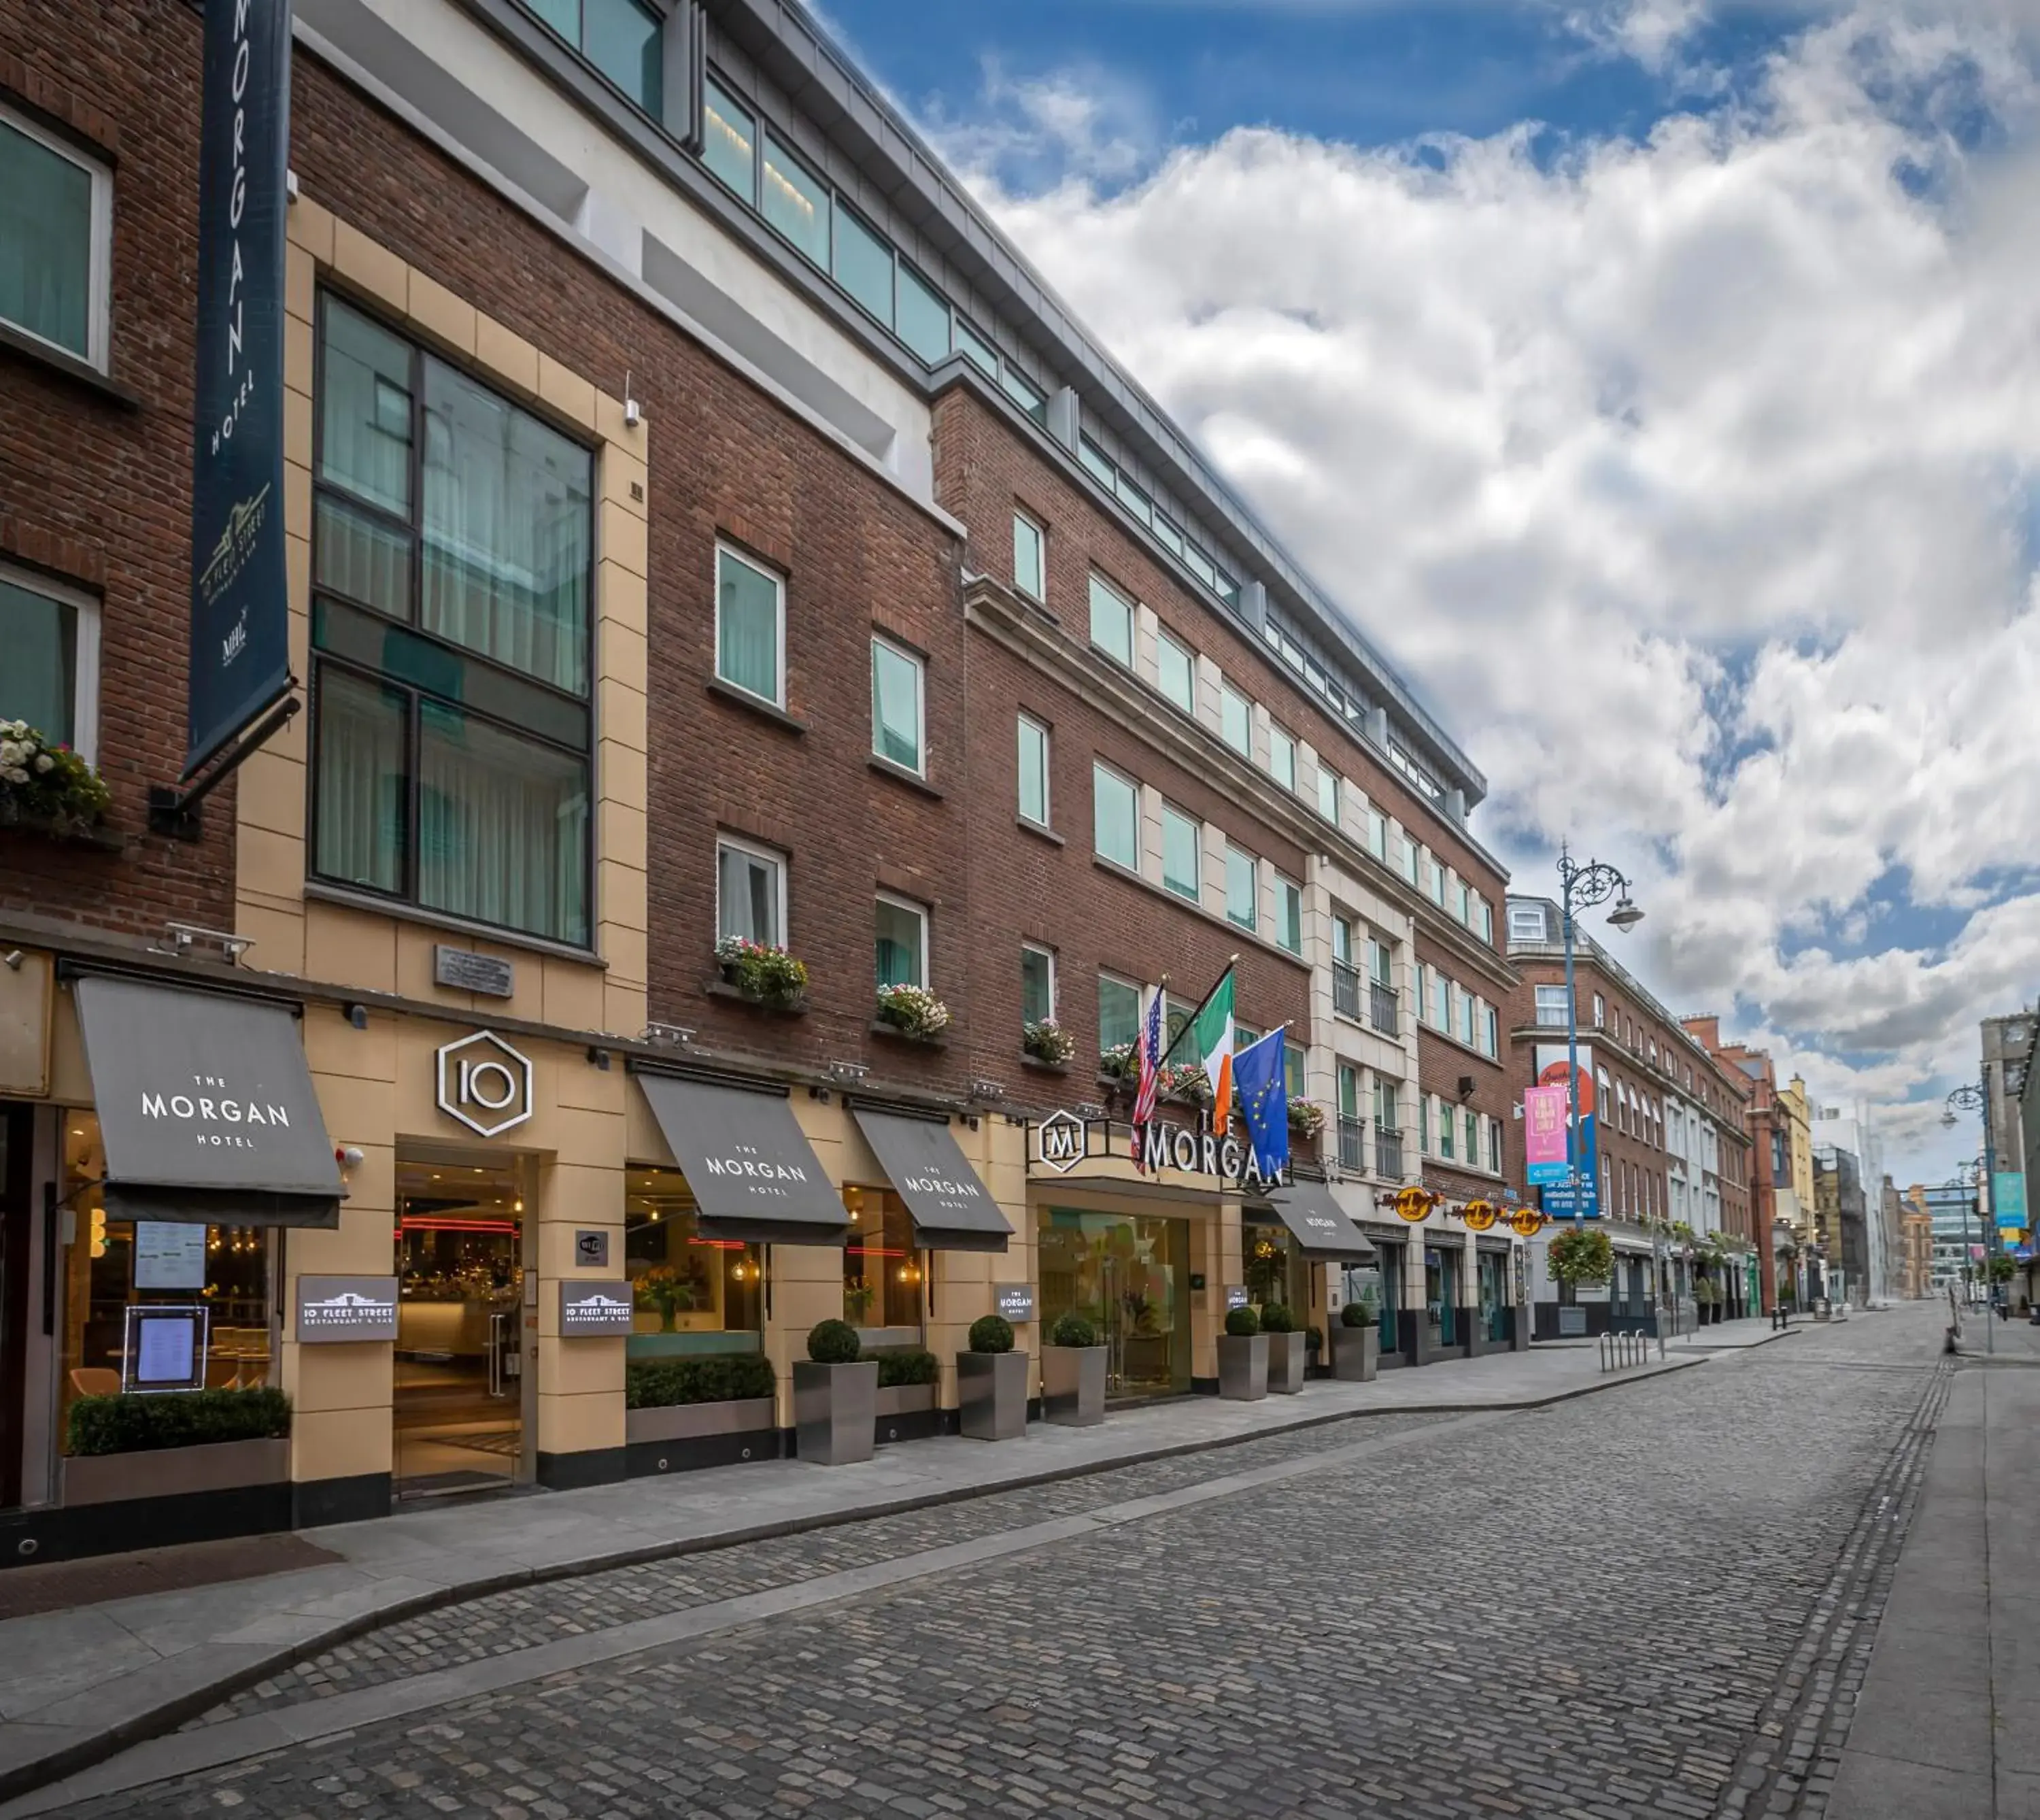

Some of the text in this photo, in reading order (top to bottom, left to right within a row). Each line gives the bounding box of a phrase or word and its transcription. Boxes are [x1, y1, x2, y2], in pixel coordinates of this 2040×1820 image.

[211, 369, 254, 456] HOTEL
[193, 1075, 226, 1088] THE
[141, 1092, 290, 1128] MORGAN
[1200, 1109, 1236, 1136] TE
[197, 1134, 254, 1147] HOTEL
[735, 1145, 758, 1155] THE
[1144, 1120, 1284, 1187] MORGAN
[704, 1156, 808, 1184] MORGAN
[748, 1185, 789, 1198] HOTEL
[904, 1175, 981, 1198] MORGAN
[1000, 1298, 1032, 1307] MORGAN
[323, 1309, 353, 1317] FLEET
[358, 1308, 393, 1317] STREET
[579, 1307, 601, 1316] FLEET
[604, 1307, 631, 1315] STREET
